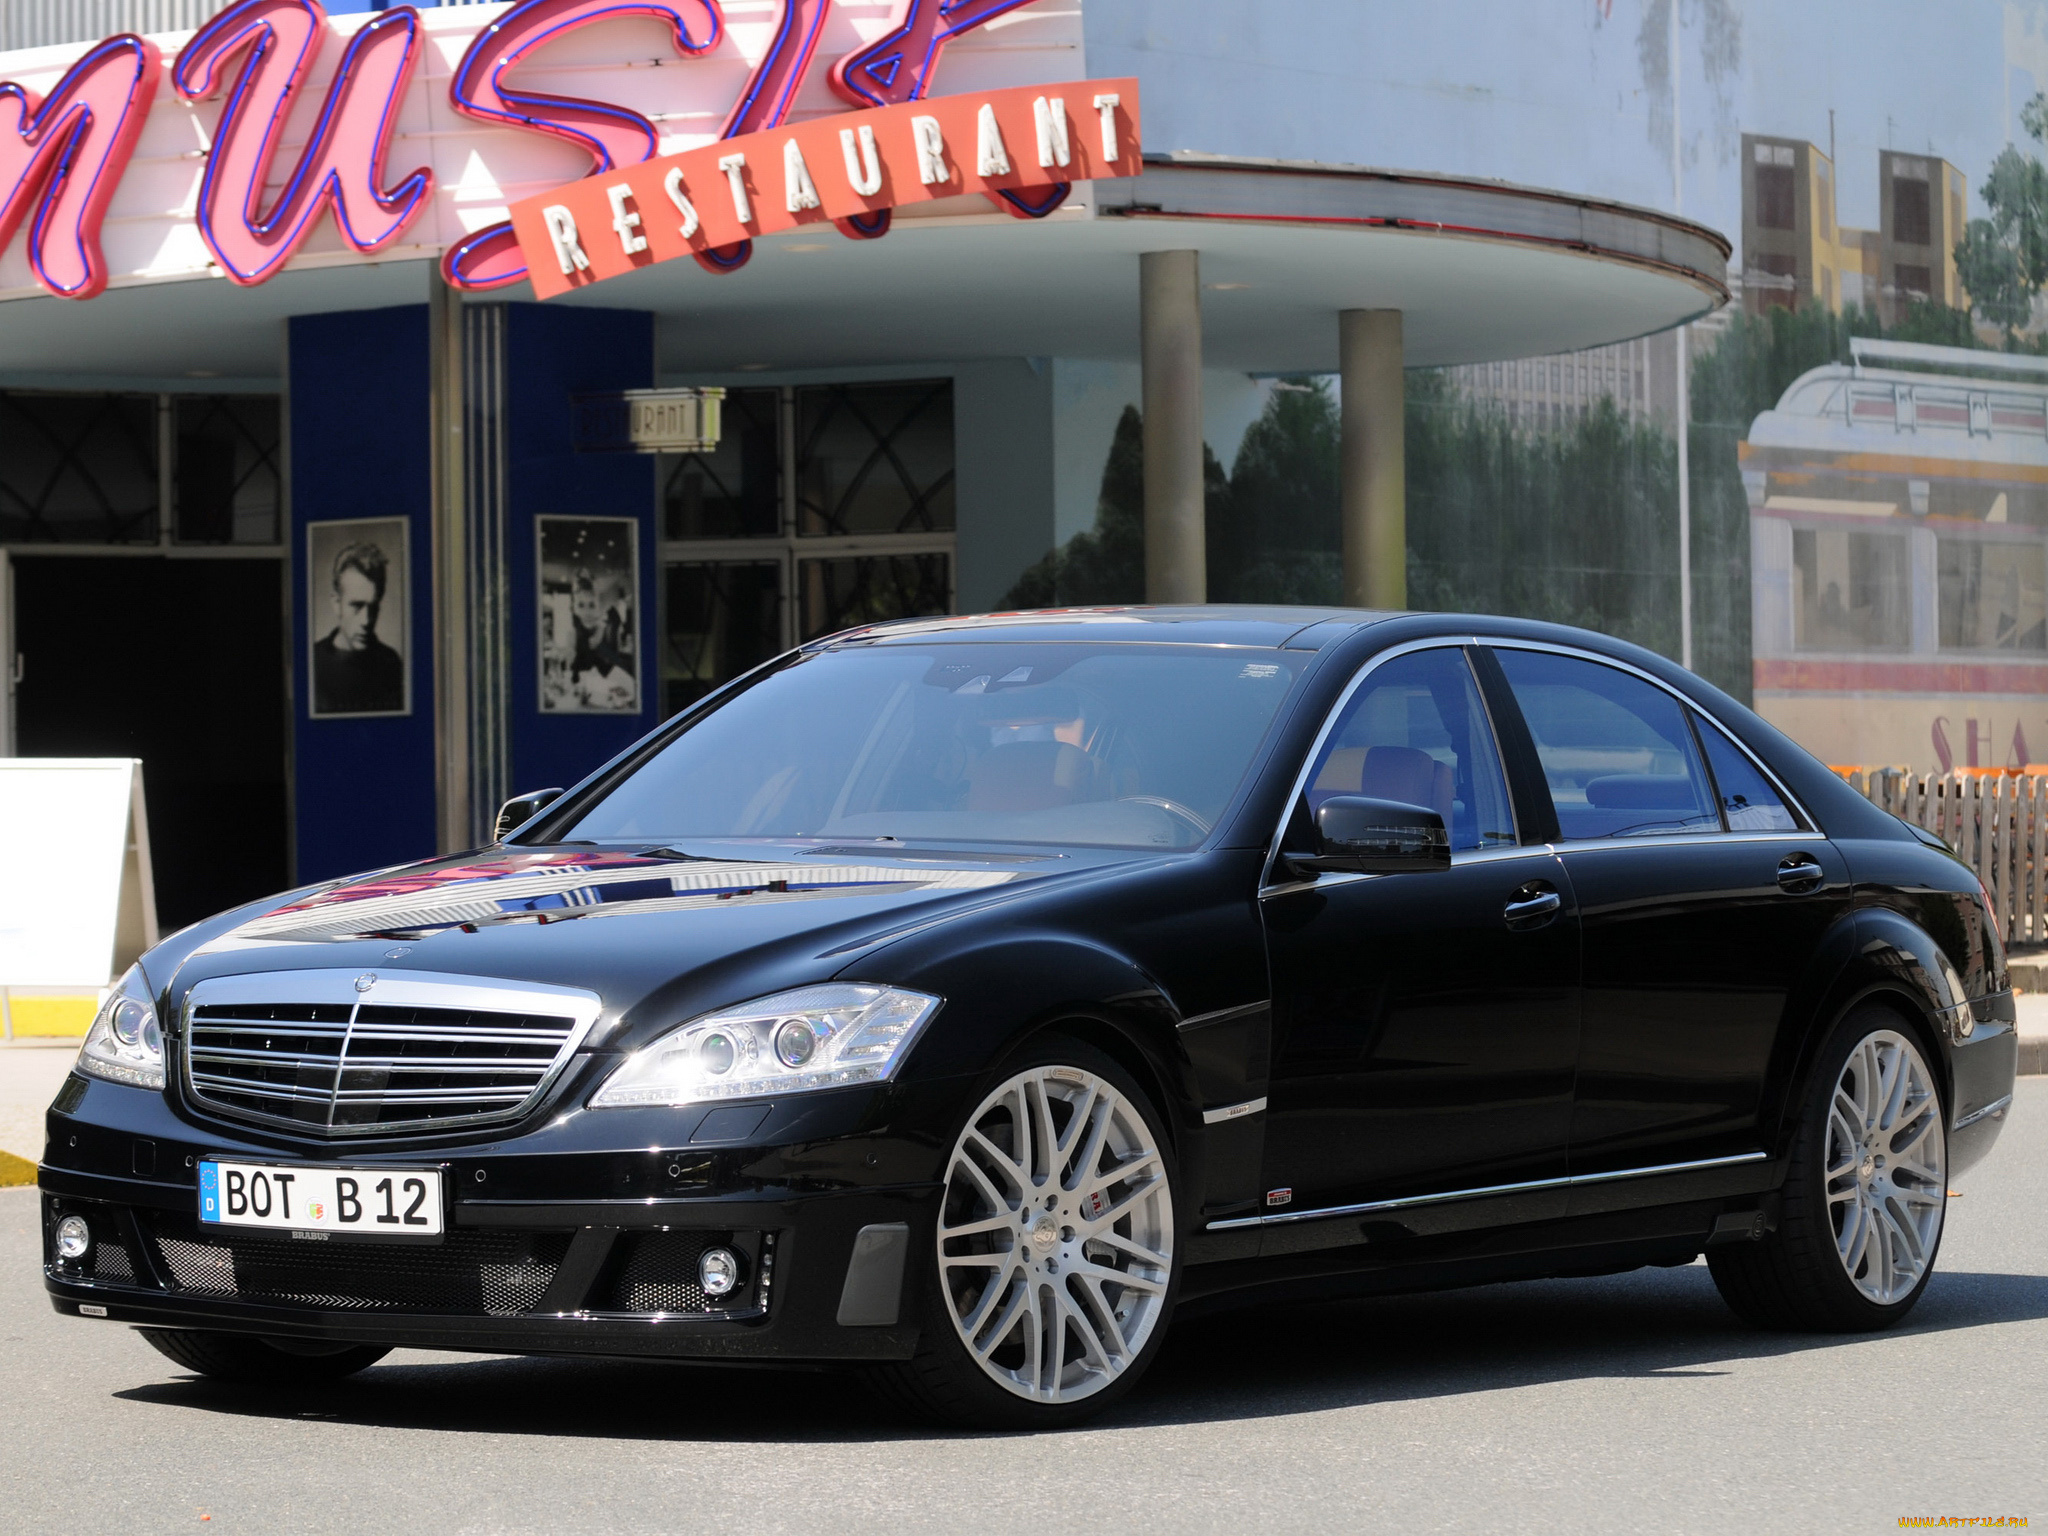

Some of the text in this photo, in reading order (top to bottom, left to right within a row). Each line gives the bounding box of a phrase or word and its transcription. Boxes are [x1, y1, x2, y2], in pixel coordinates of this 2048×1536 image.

[541, 93, 1121, 275] RESTAURANT
[1931, 716, 2048, 776] SHA
[206, 1197, 215, 1212] D
[226, 1170, 428, 1226] BOT B 12
[292, 1231, 331, 1241] BRABUS
